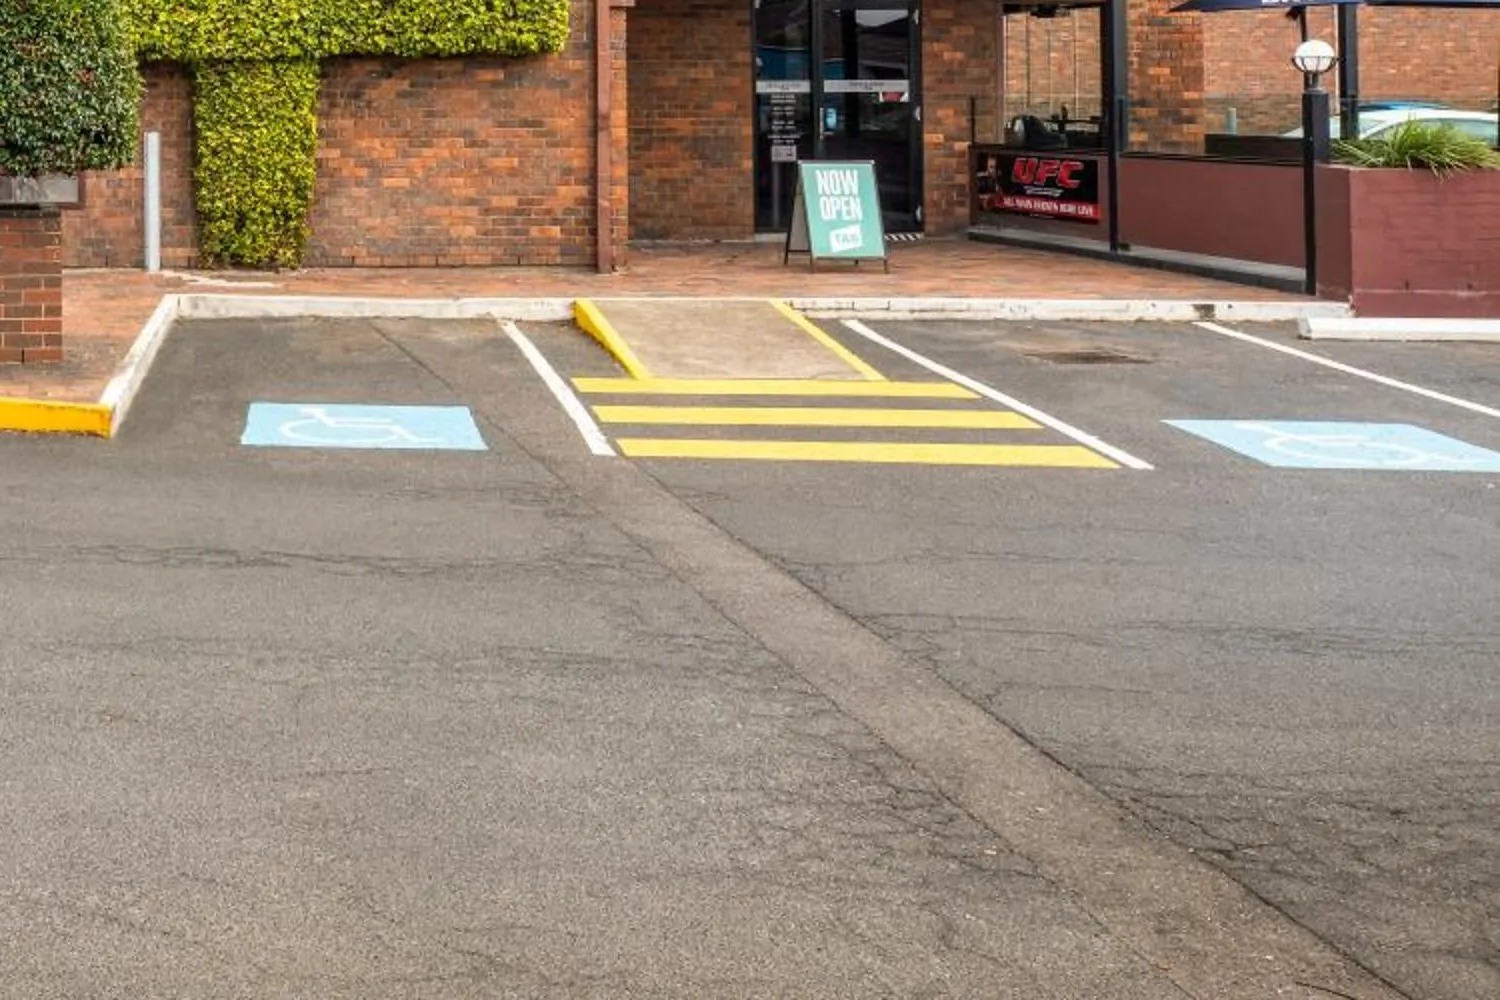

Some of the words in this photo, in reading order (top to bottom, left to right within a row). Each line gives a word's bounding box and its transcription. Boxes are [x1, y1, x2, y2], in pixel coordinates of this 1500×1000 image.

[816, 169, 858, 196] NOW
[1012, 157, 1084, 189] UFC
[820, 195, 863, 221] OPEN
